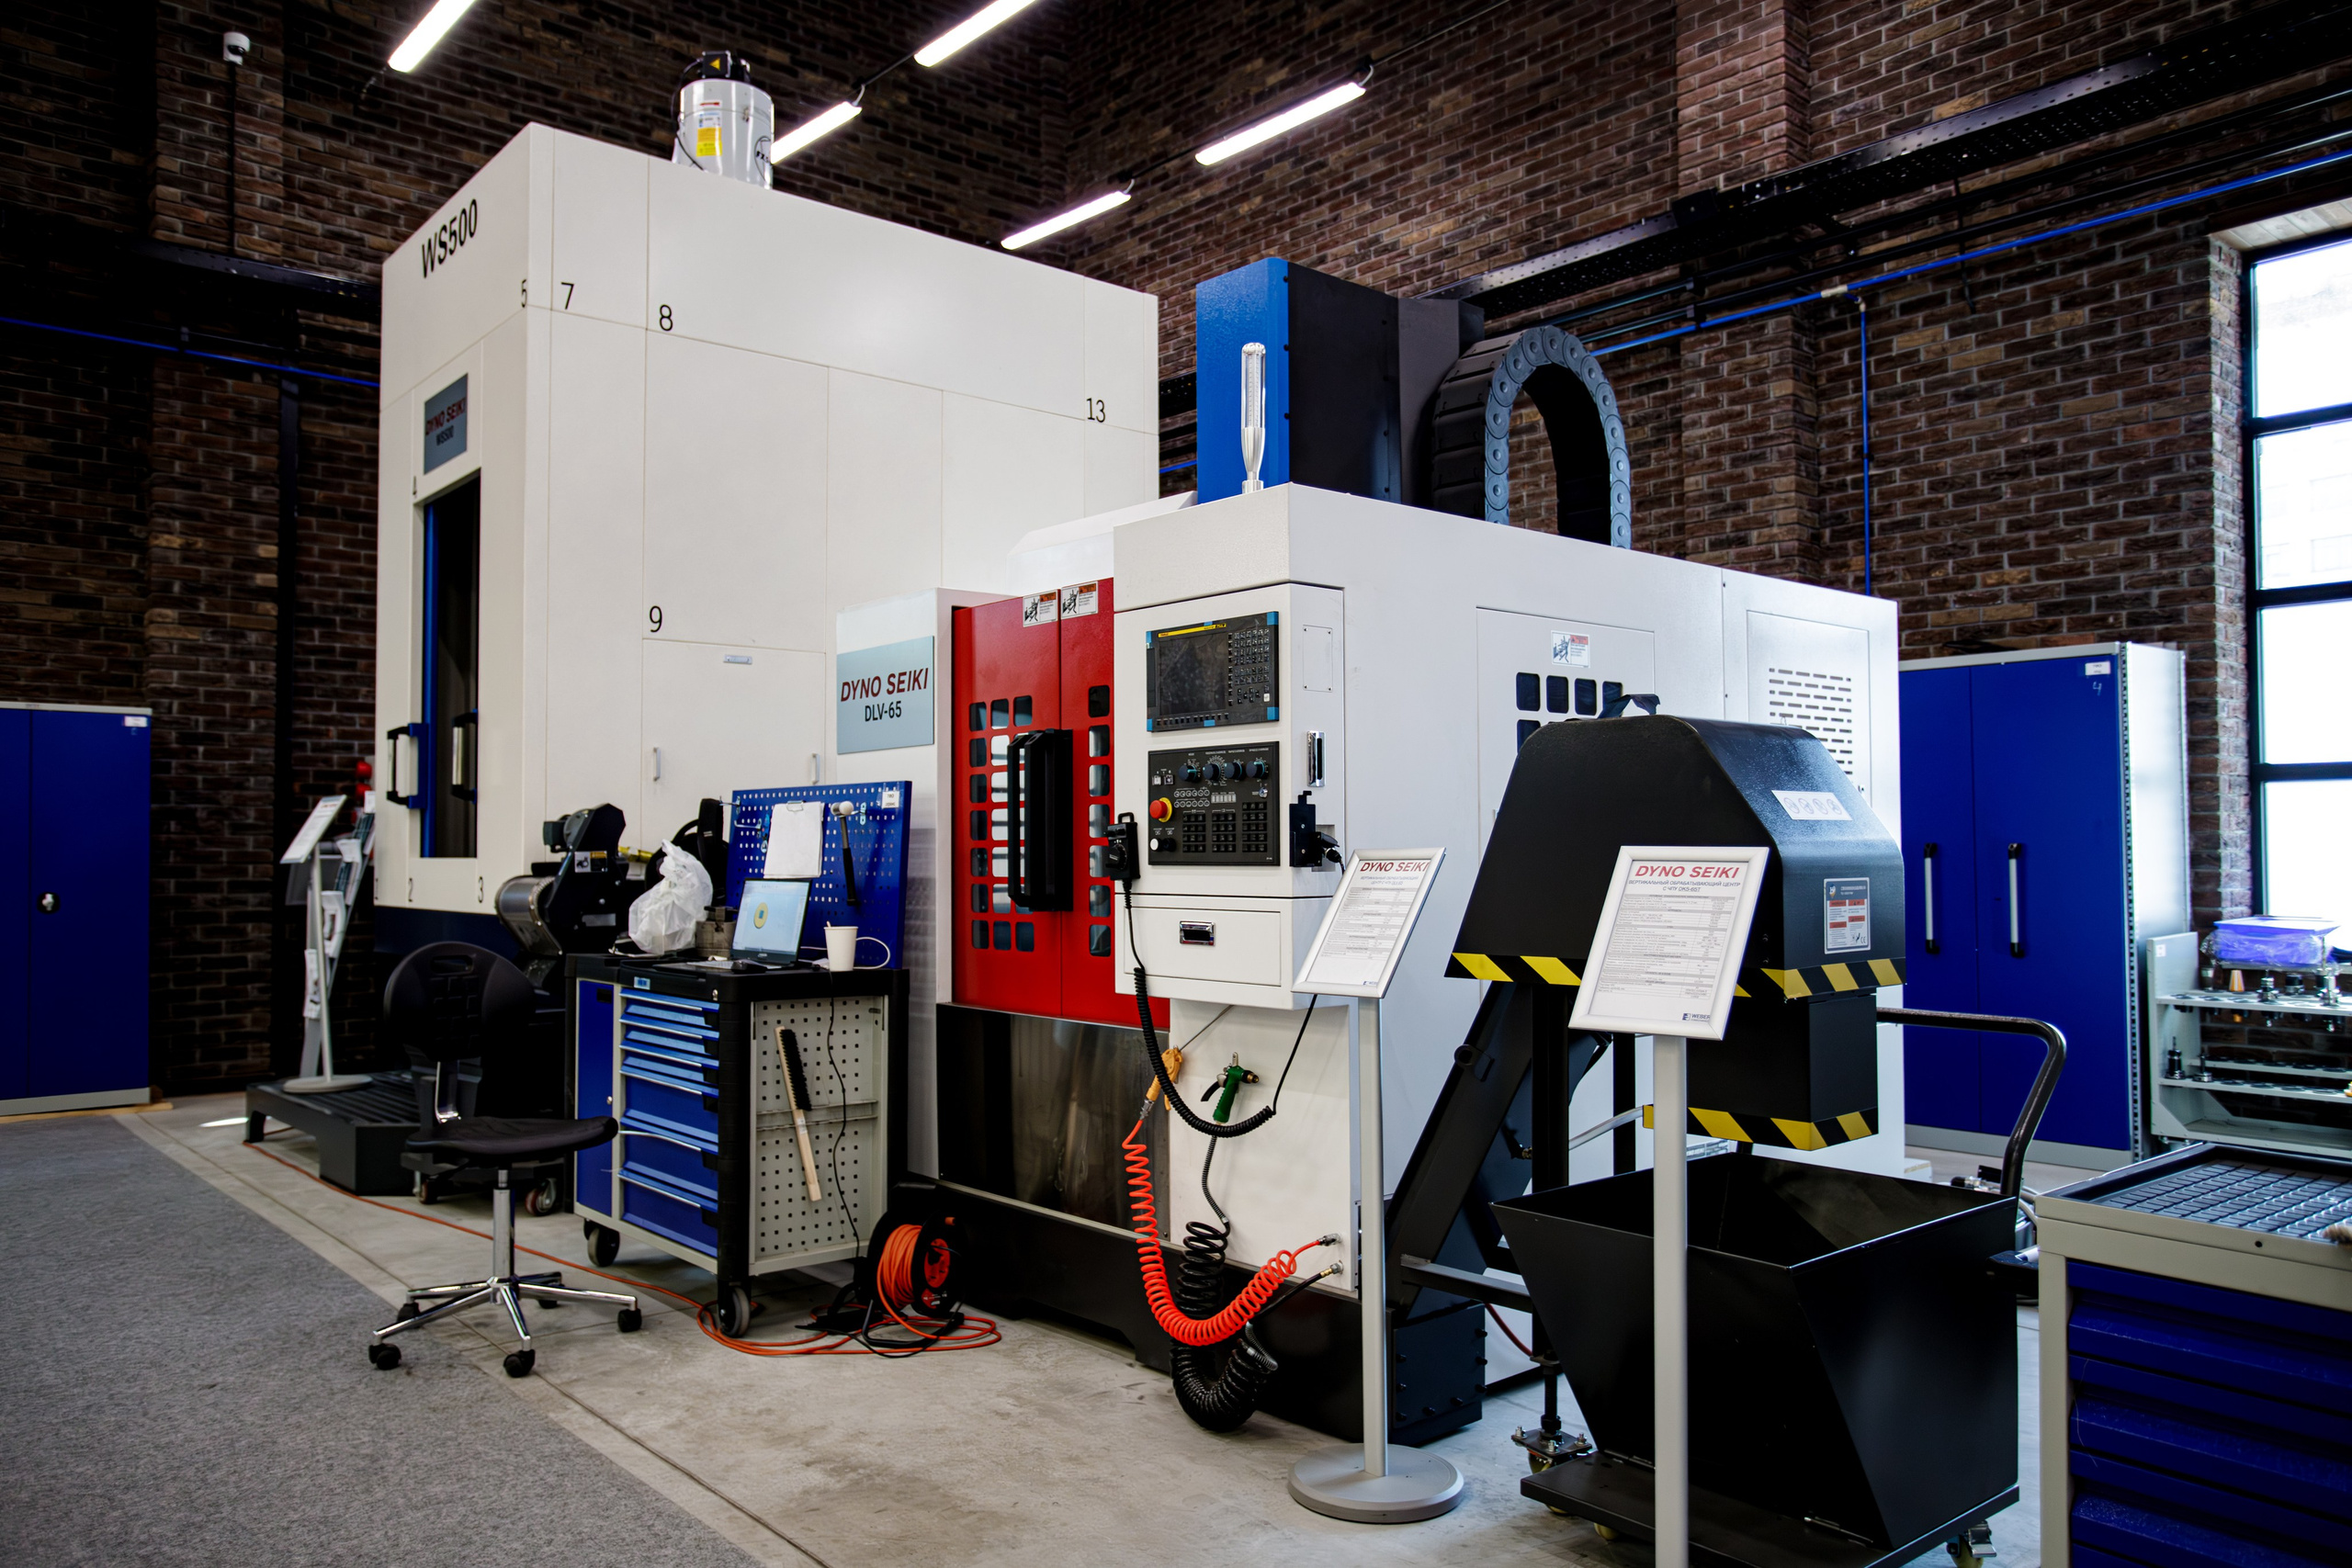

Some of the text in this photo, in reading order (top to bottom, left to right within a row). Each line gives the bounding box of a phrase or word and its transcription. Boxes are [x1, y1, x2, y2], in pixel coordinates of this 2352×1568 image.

[422, 198, 478, 278] WS500
[521, 279, 527, 308] 5
[560, 282, 574, 310] 7
[659, 304, 673, 332] 8
[425, 396, 467, 436] DYNO SEIKI
[1086, 398, 1106, 423] 13
[649, 605, 663, 633] 9
[841, 668, 929, 702] DYNO SEIKI
[2092, 682, 2102, 696] 4
[865, 700, 902, 722] DLV-65
[1360, 862, 1430, 872] DYNO SEIKI
[1635, 865, 1740, 879] DYNO SEIKI
[408, 877, 413, 902] 2
[478, 875, 484, 903] 3
